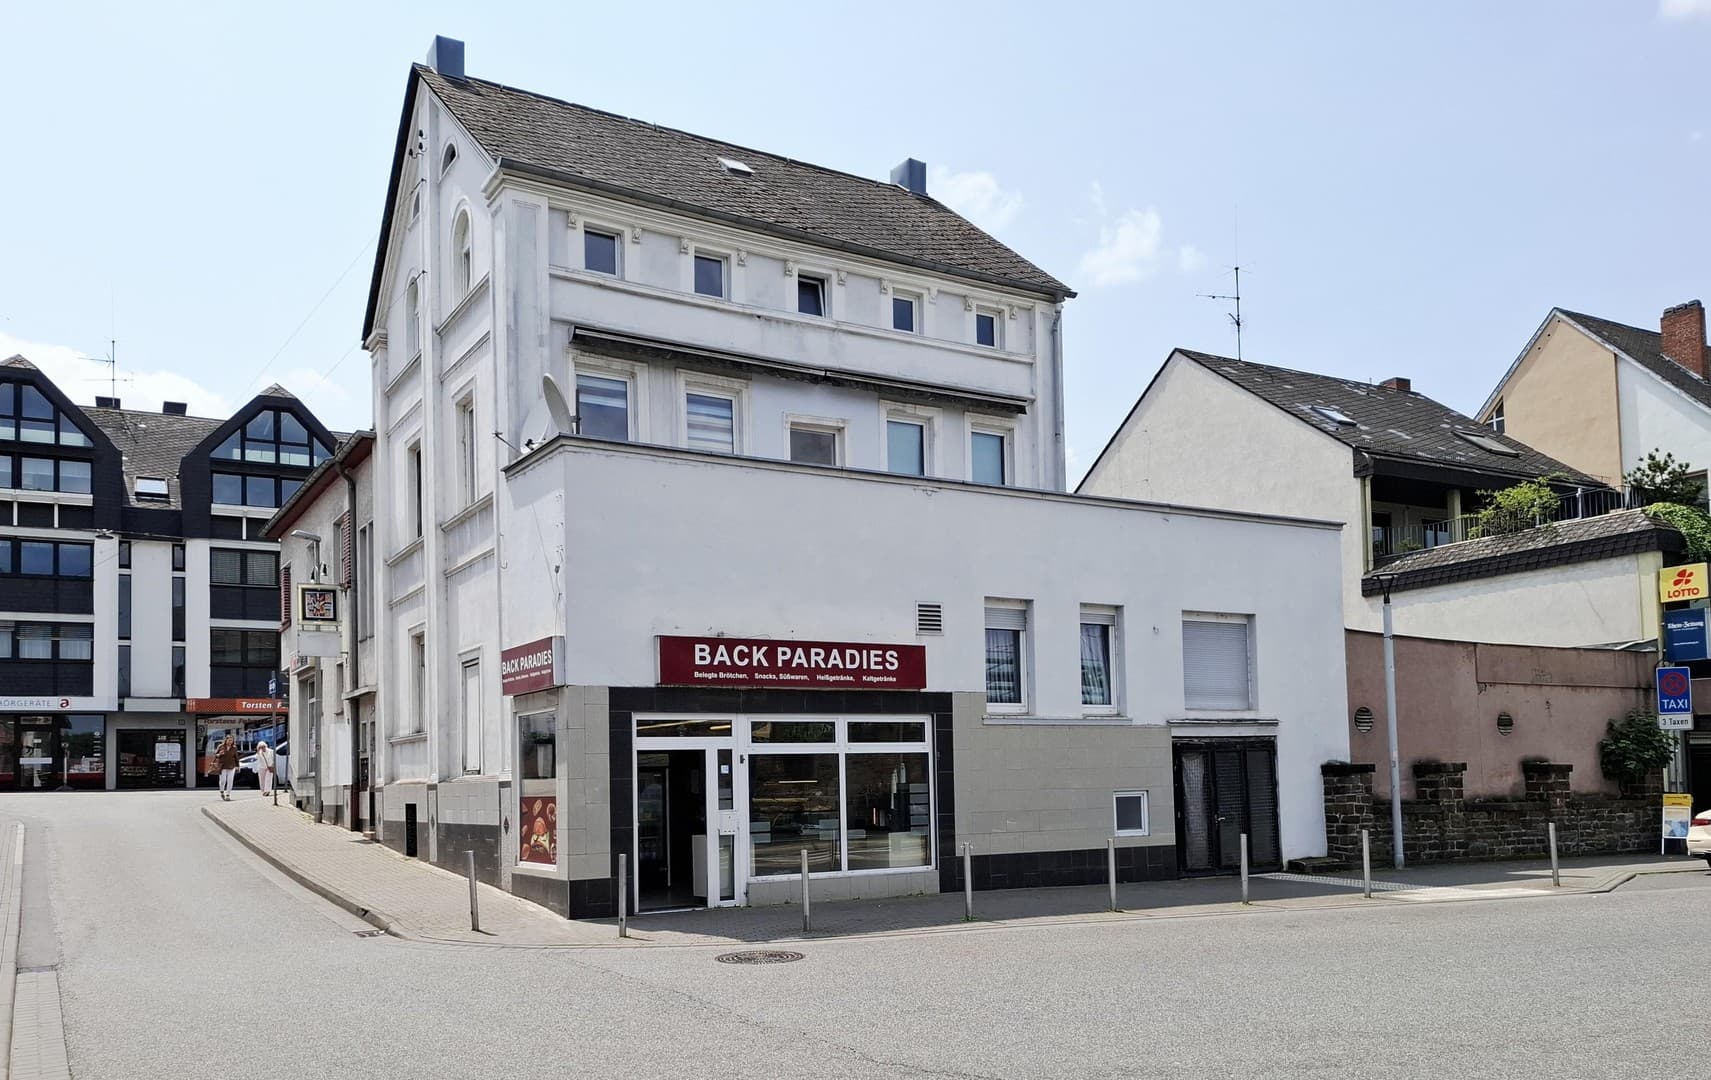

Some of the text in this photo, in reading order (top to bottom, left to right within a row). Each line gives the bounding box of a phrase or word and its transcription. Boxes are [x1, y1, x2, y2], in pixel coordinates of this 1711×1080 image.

[1667, 587, 1701, 599] LOTTO
[502, 649, 552, 675] BACK PARADIES
[694, 643, 899, 671] BACK PARADIES
[694, 671, 718, 680] Belegte
[719, 671, 749, 680] Brötchen,
[754, 672, 778, 681] Snacks,
[862, 675, 897, 684] Kaltgetränke
[1661, 698, 1688, 710] TAXI
[1662, 717, 1689, 726] 3 Taxen
